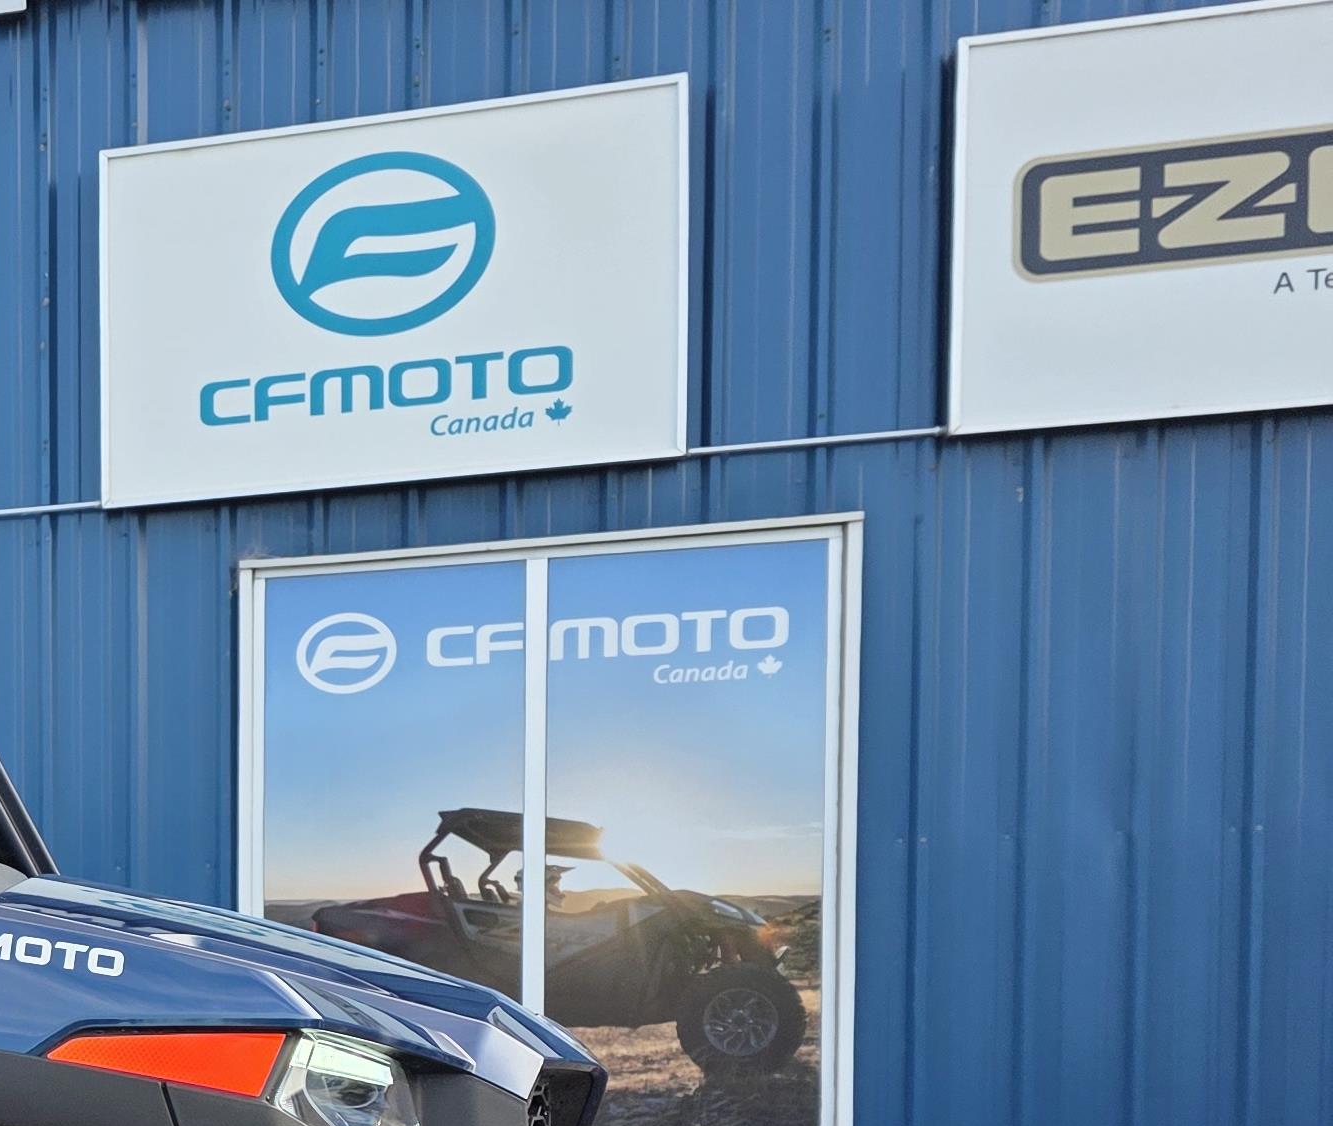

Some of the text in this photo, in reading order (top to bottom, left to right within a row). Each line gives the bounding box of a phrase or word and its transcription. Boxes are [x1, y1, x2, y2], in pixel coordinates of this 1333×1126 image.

[1273, 271, 1294, 294] A
[199, 345, 574, 427] CFMOTO
[429, 406, 535, 437] Canada
[426, 606, 790, 668] CFMOTO
[652, 660, 749, 685] Canada
